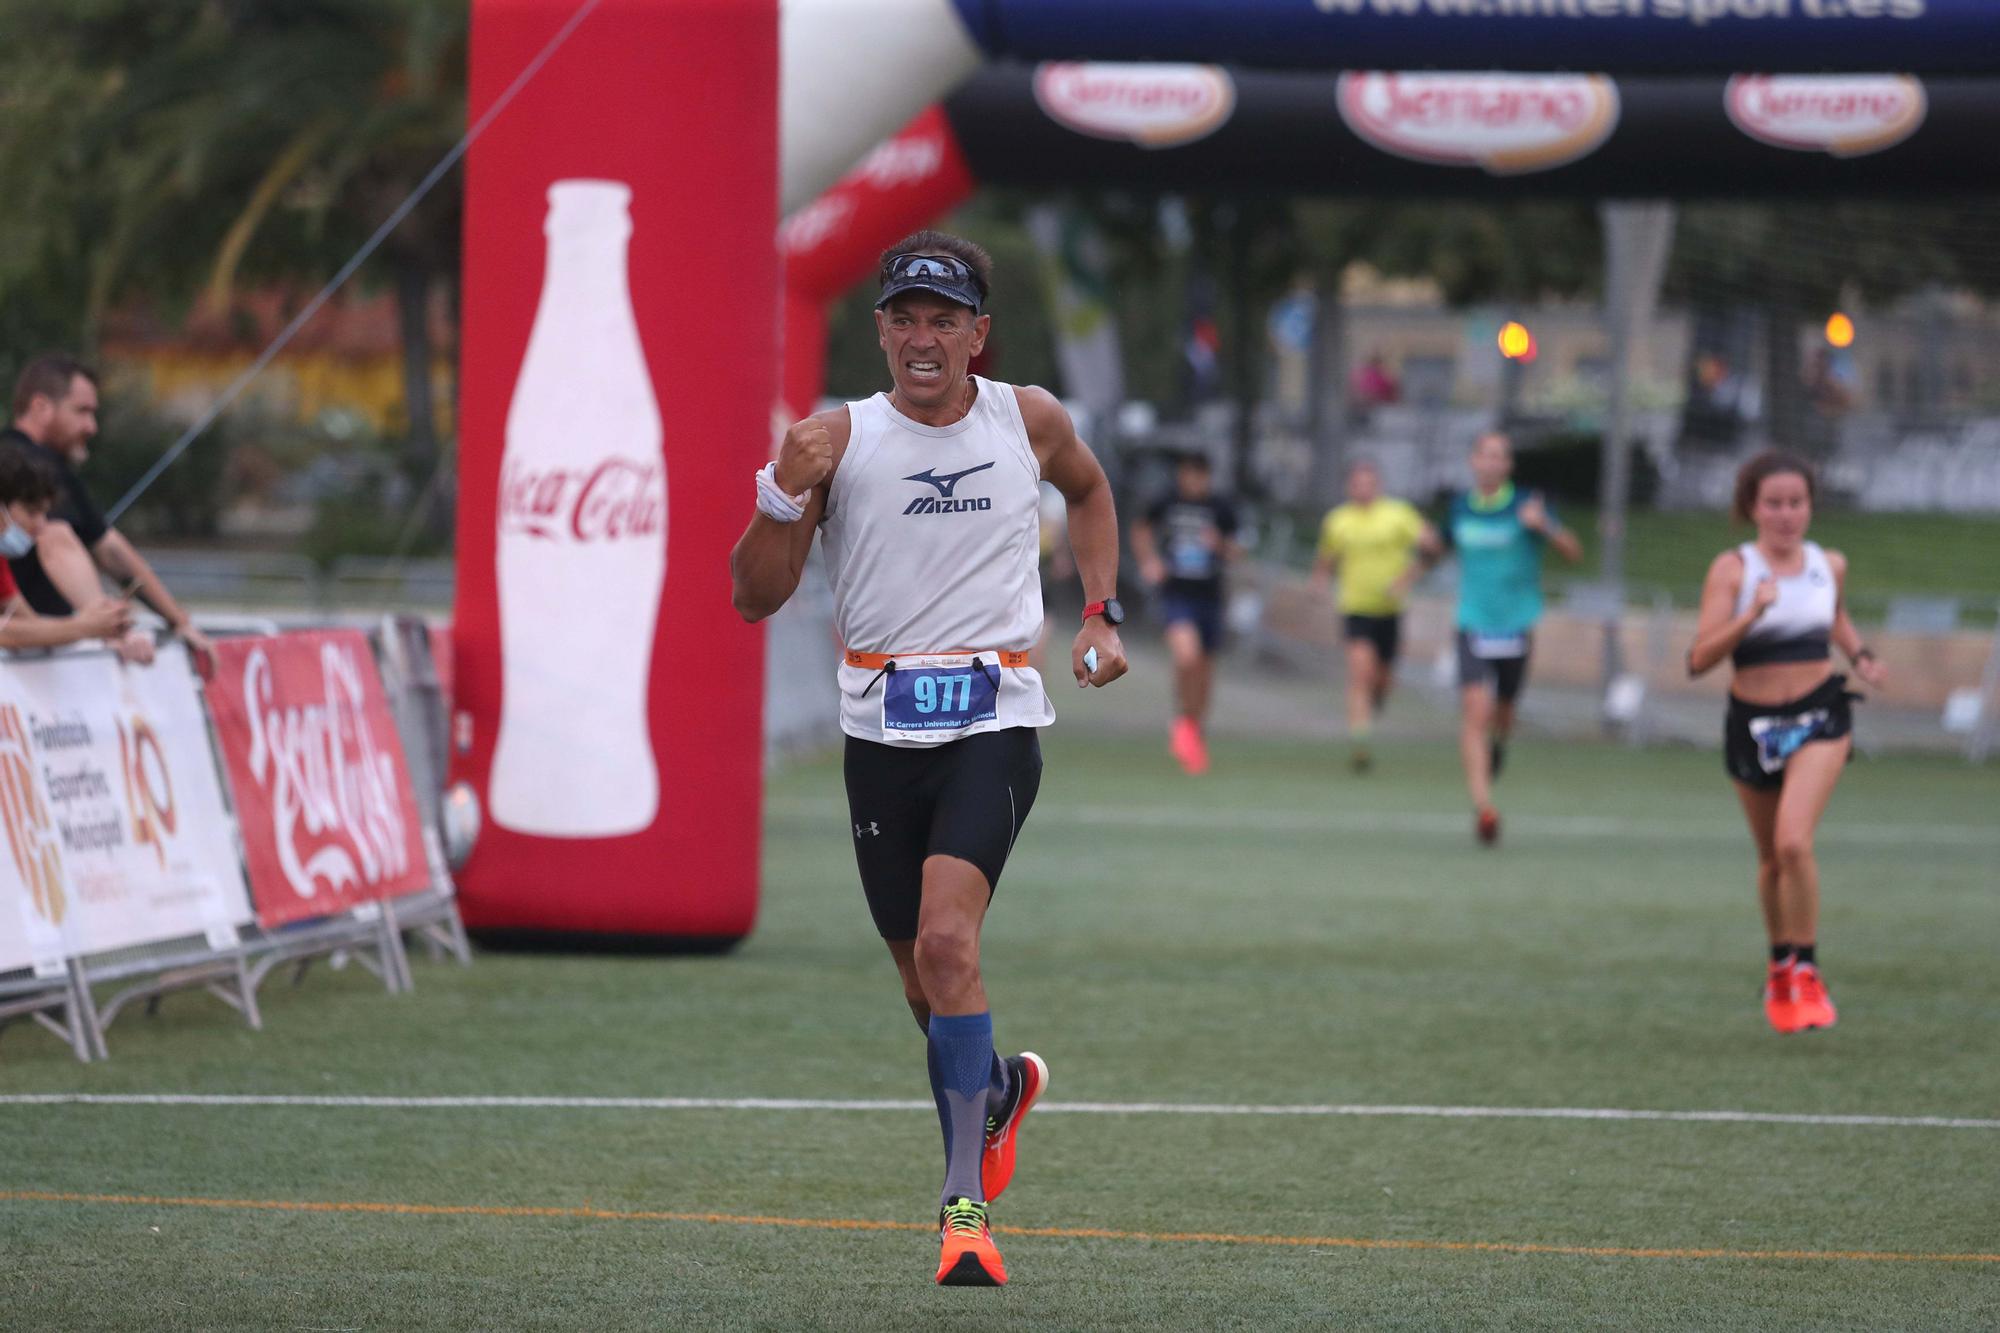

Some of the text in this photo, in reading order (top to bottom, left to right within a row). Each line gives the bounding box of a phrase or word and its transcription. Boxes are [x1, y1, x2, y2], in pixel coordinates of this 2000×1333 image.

[902, 497, 991, 515] MIZUNO
[914, 674, 971, 714] 977
[924, 720, 961, 728] Universitat
